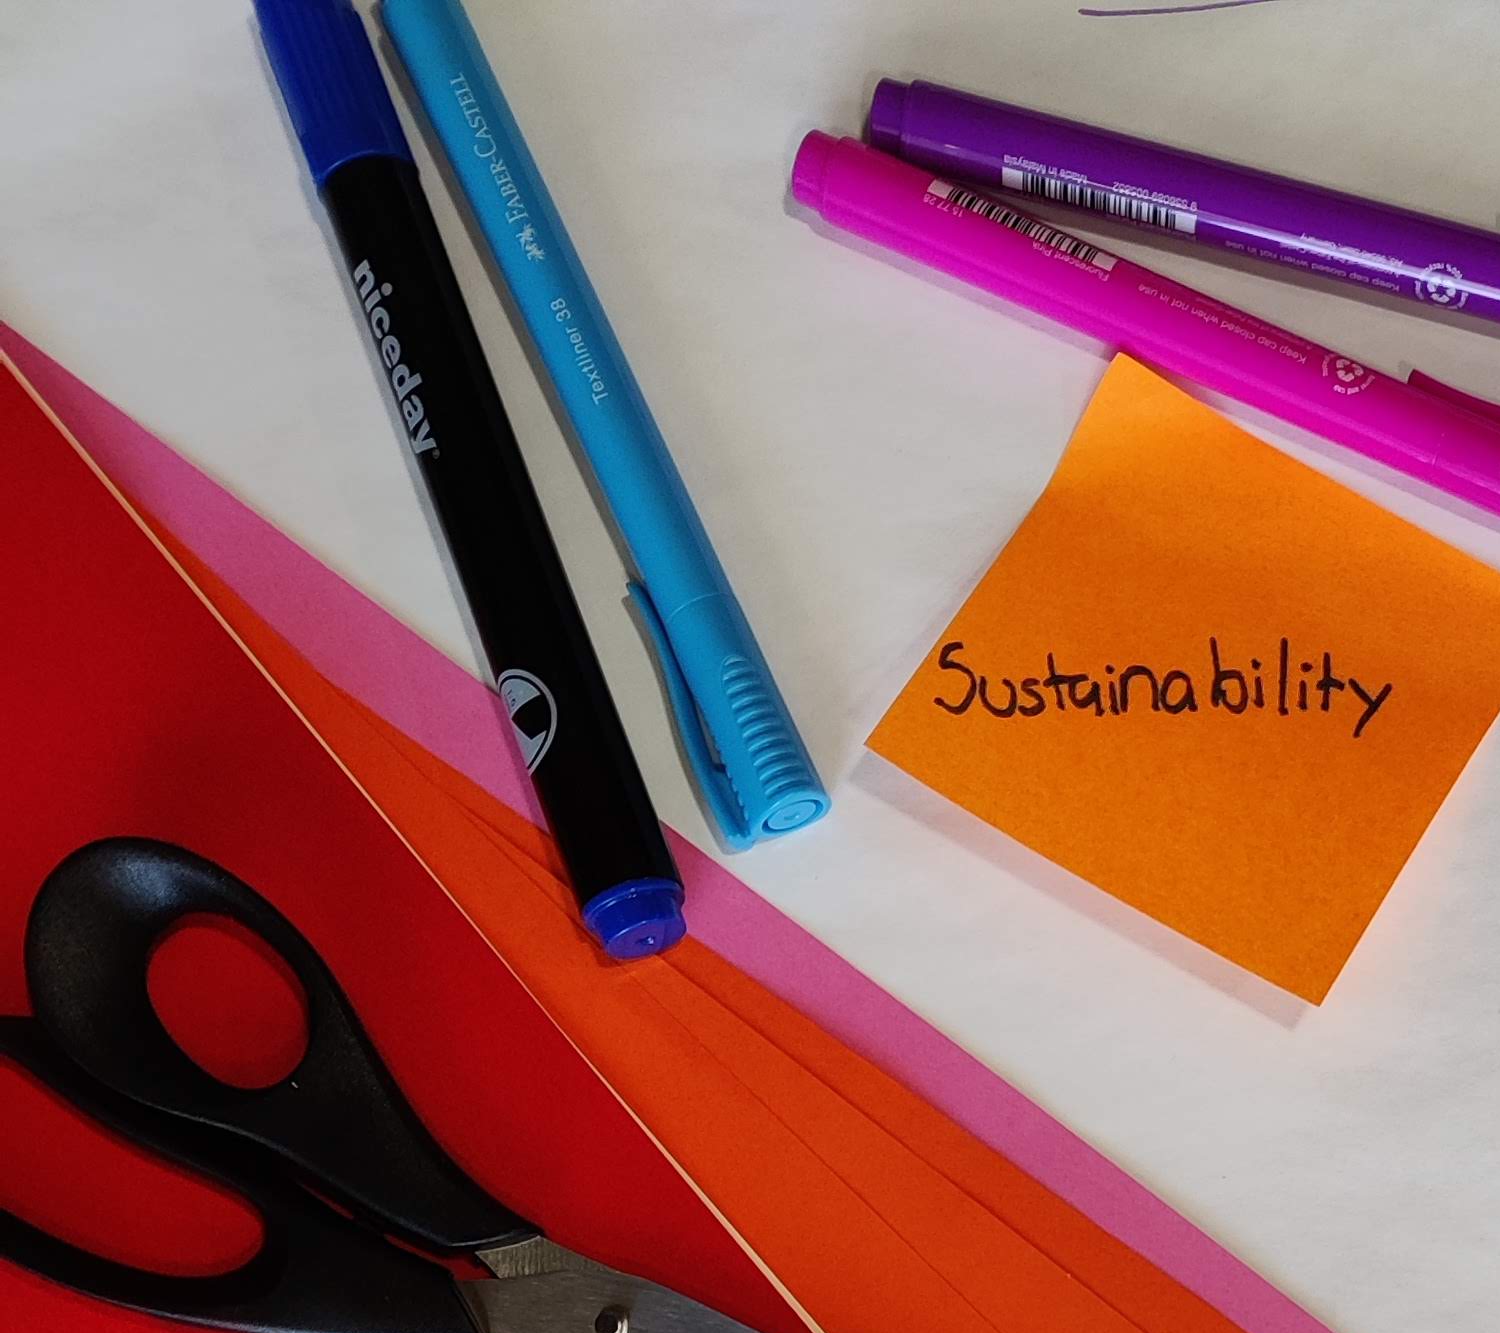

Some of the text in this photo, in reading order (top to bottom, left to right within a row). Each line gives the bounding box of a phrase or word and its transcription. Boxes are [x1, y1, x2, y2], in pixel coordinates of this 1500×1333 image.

[1191, 307, 1219, 324] when
[1220, 320, 1256, 340] closed
[354, 259, 437, 454] niceday
[550, 298, 608, 404] Textliner 38
[1279, 345, 1307, 364] Keep
[934, 637, 1393, 738] Sustainability
